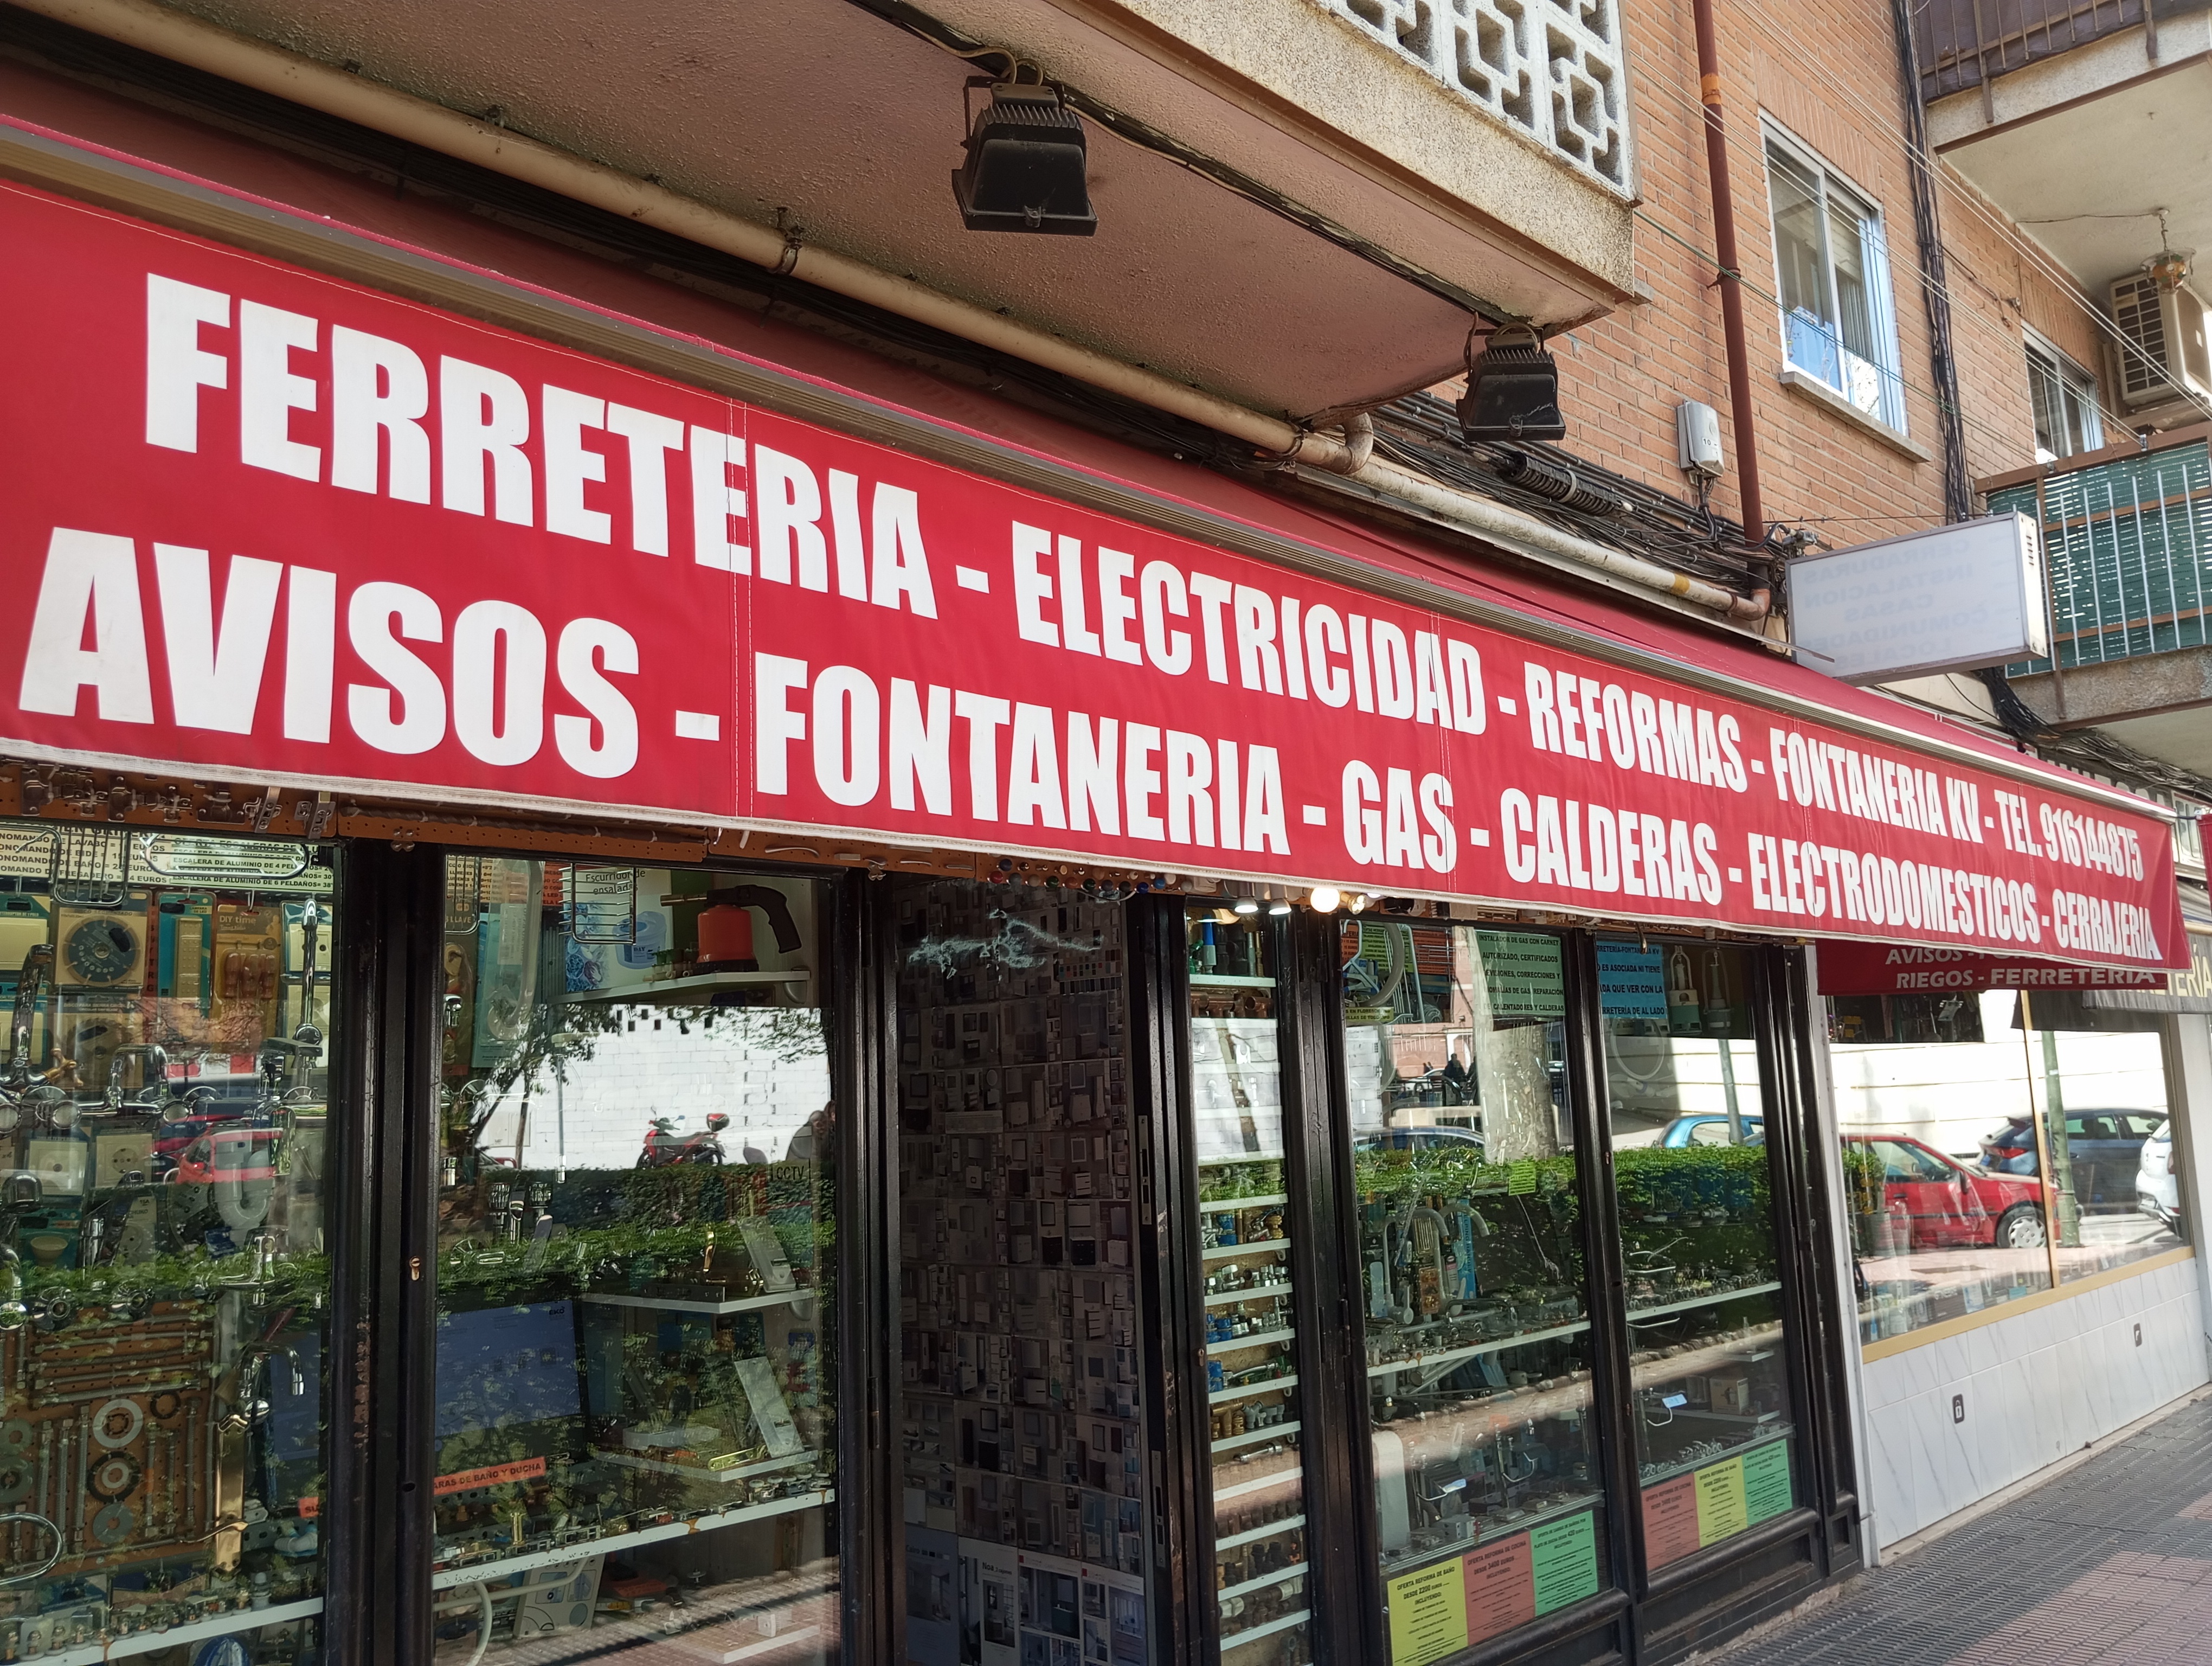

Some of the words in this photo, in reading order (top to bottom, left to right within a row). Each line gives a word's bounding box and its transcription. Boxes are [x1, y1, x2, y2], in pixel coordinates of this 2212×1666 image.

[146, 272, 938, 619] FERRETERIA
[1012, 520, 1487, 735] ELECTRICIDAD
[1524, 661, 1747, 793] REFORMAS
[1770, 727, 1947, 837] FONTANERIA
[1945, 777, 1983, 844] KV
[1995, 789, 2042, 857] TEL.
[2040, 803, 2144, 881] 916144875
[19, 526, 639, 779] AVISOS
[755, 652, 1291, 856] FONTANERIA
[1342, 760, 1457, 874] GAS
[1500, 788, 1722, 905] CALDERAS
[1747, 832, 2040, 944] ELECTRODOMESTICOS
[2052, 888, 2163, 960] CERRAJERIA
[1479, 934, 1510, 943] INSTALADOR
[1520, 954, 1558, 963] CERTIFICADOS
[1885, 948, 1962, 965] AVISOS
[1516, 971, 1555, 979] CORRECCIONES
[1610, 964, 1637, 972] ASOCIADA
[1645, 965, 1661, 973] TIENE
[1896, 970, 1973, 988] RIEGOS
[1991, 967, 2156, 984] FERRETERIA
[1533, 988, 1564, 996] REPARACIÓN
[1612, 984, 1625, 993] QUE
[1626, 985, 1640, 994] VER
[1641, 985, 1654, 994] CON
[1493, 1003, 1533, 1011] CALENTADORES
[1632, 1007, 1640, 1015] DE
[776, 1165, 805, 1180] CCTV
[460, 1476, 472, 1484] DE
[474, 1471, 499, 1482] BAÑO
[510, 1463, 541, 1475] DUCHA
[1467, 1556, 1484, 1566] OFERTA
[1484, 1549, 1504, 1560] REFORMA
[1511, 1541, 1526, 1551] COCINA
[1474, 1565, 1487, 1575] DESDE
[1488, 1559, 1500, 1569] 3400
[1501, 1555, 1515, 1565] EUROS
[1397, 1581, 1414, 1590] OFERTA
[1415, 1574, 1436, 1584] REFORMA
[1443, 1566, 1455, 1575] BAÑO
[1404, 1590, 1418, 1599] DESDE
[1419, 1585, 1431, 1594] 2200
